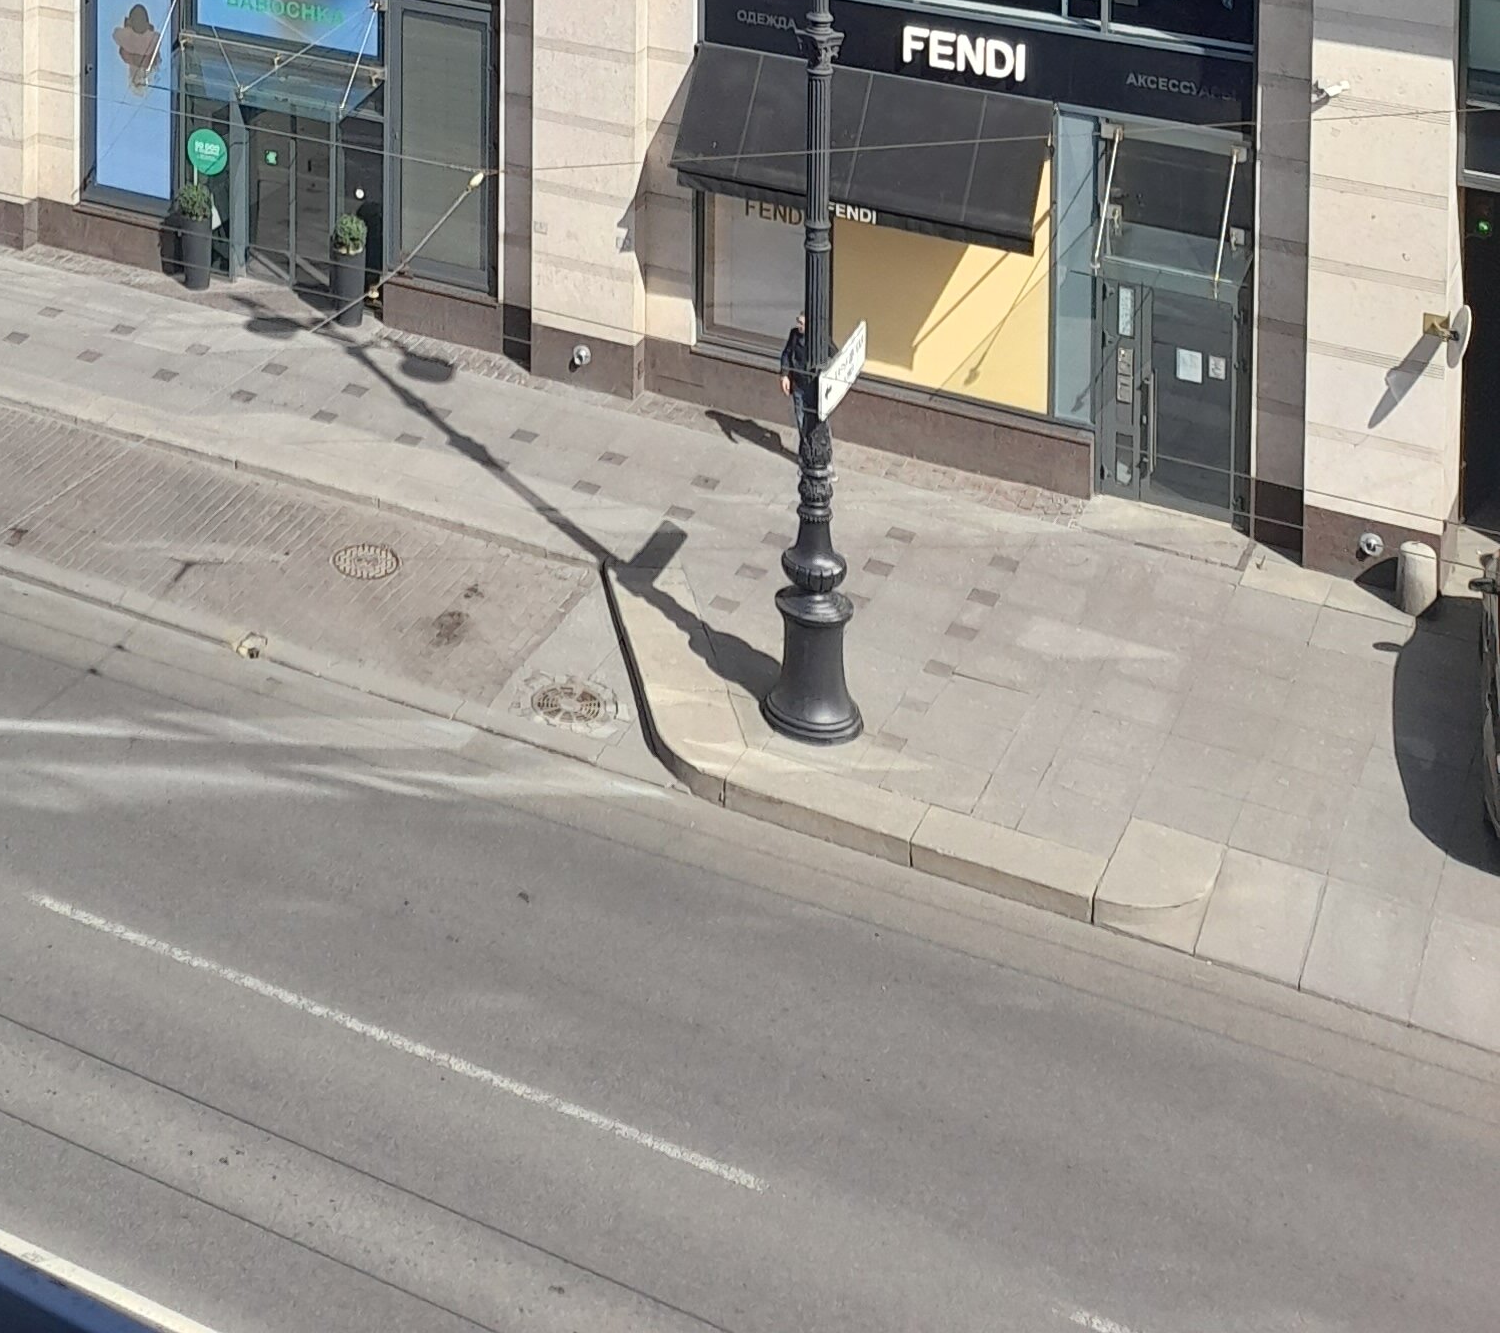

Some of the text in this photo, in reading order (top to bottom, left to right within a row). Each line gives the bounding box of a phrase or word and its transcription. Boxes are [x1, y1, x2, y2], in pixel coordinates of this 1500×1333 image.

[736, 9, 797, 31] ОДЕЖДА
[902, 25, 1026, 82] FENDI
[745, 199, 803, 226] FEND
